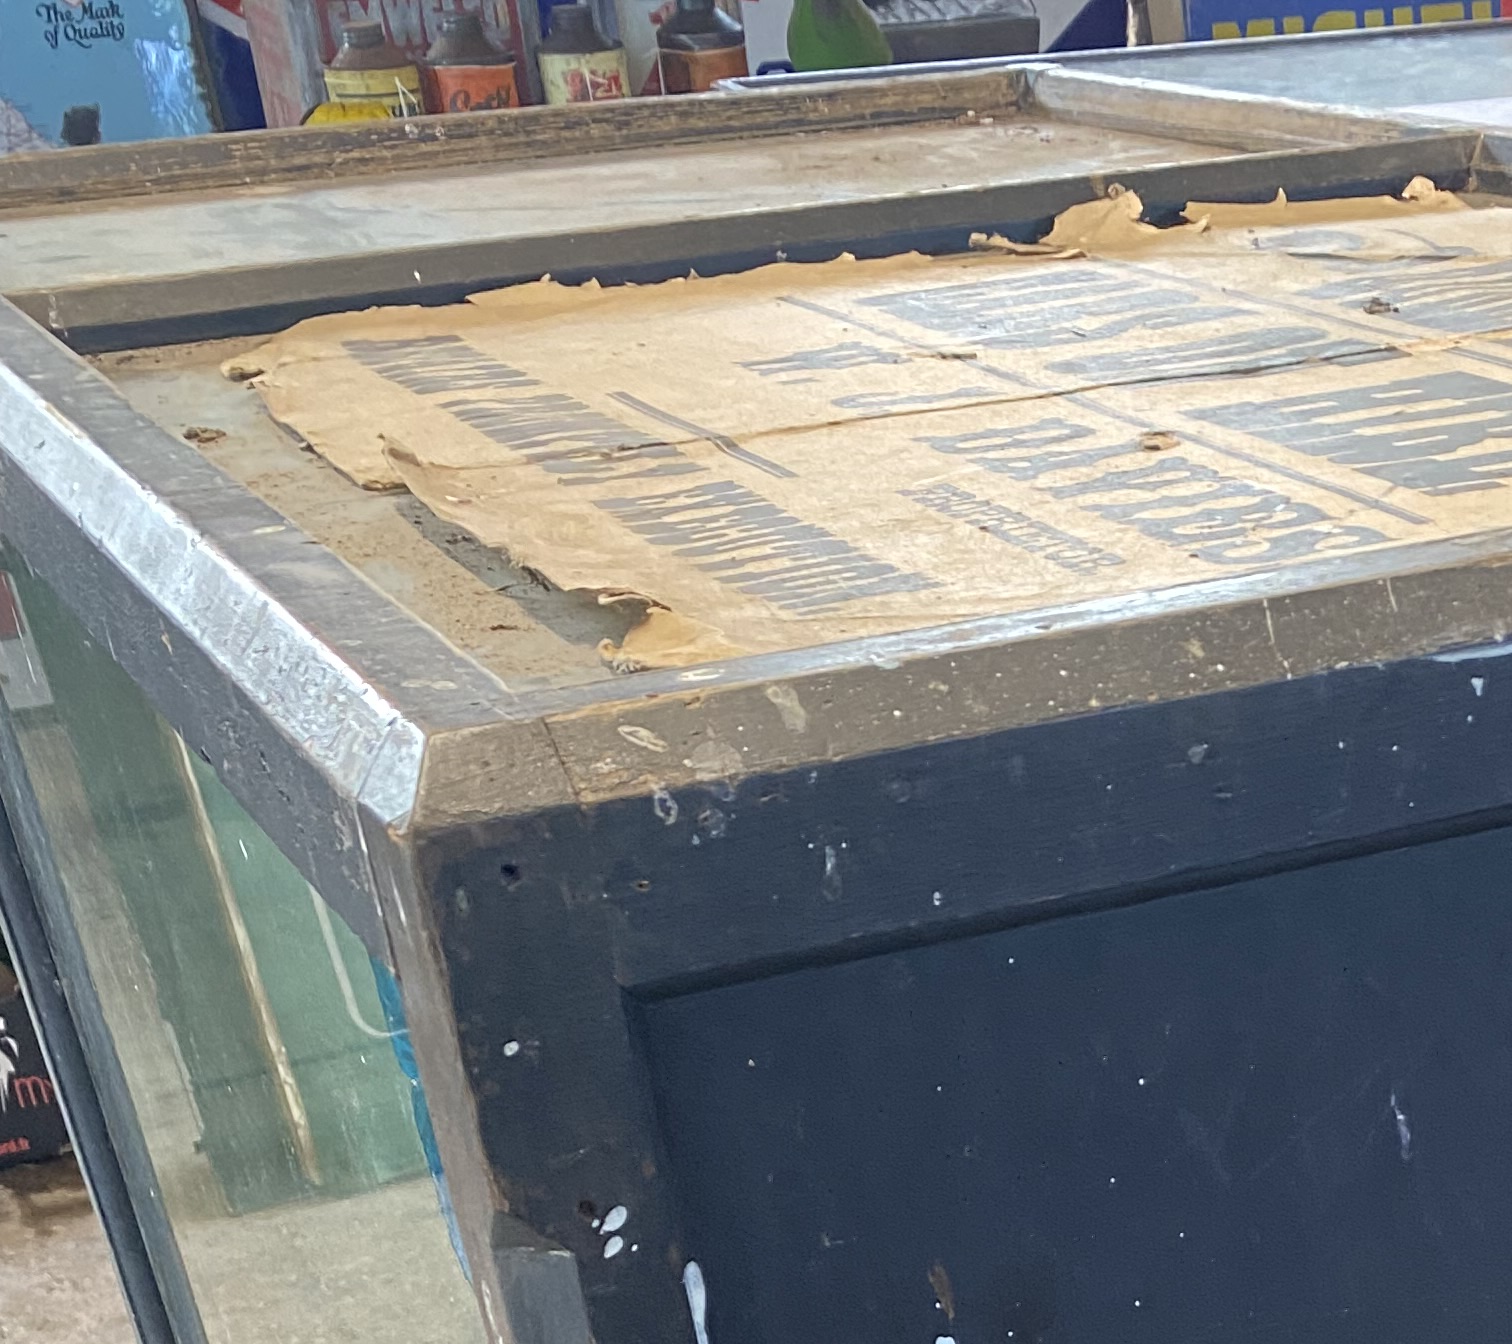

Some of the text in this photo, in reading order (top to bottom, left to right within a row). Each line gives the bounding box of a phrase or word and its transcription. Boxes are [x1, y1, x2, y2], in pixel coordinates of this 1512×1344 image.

[36, 1, 124, 23] The Mark
[44, 20, 125, 49] of Quality
